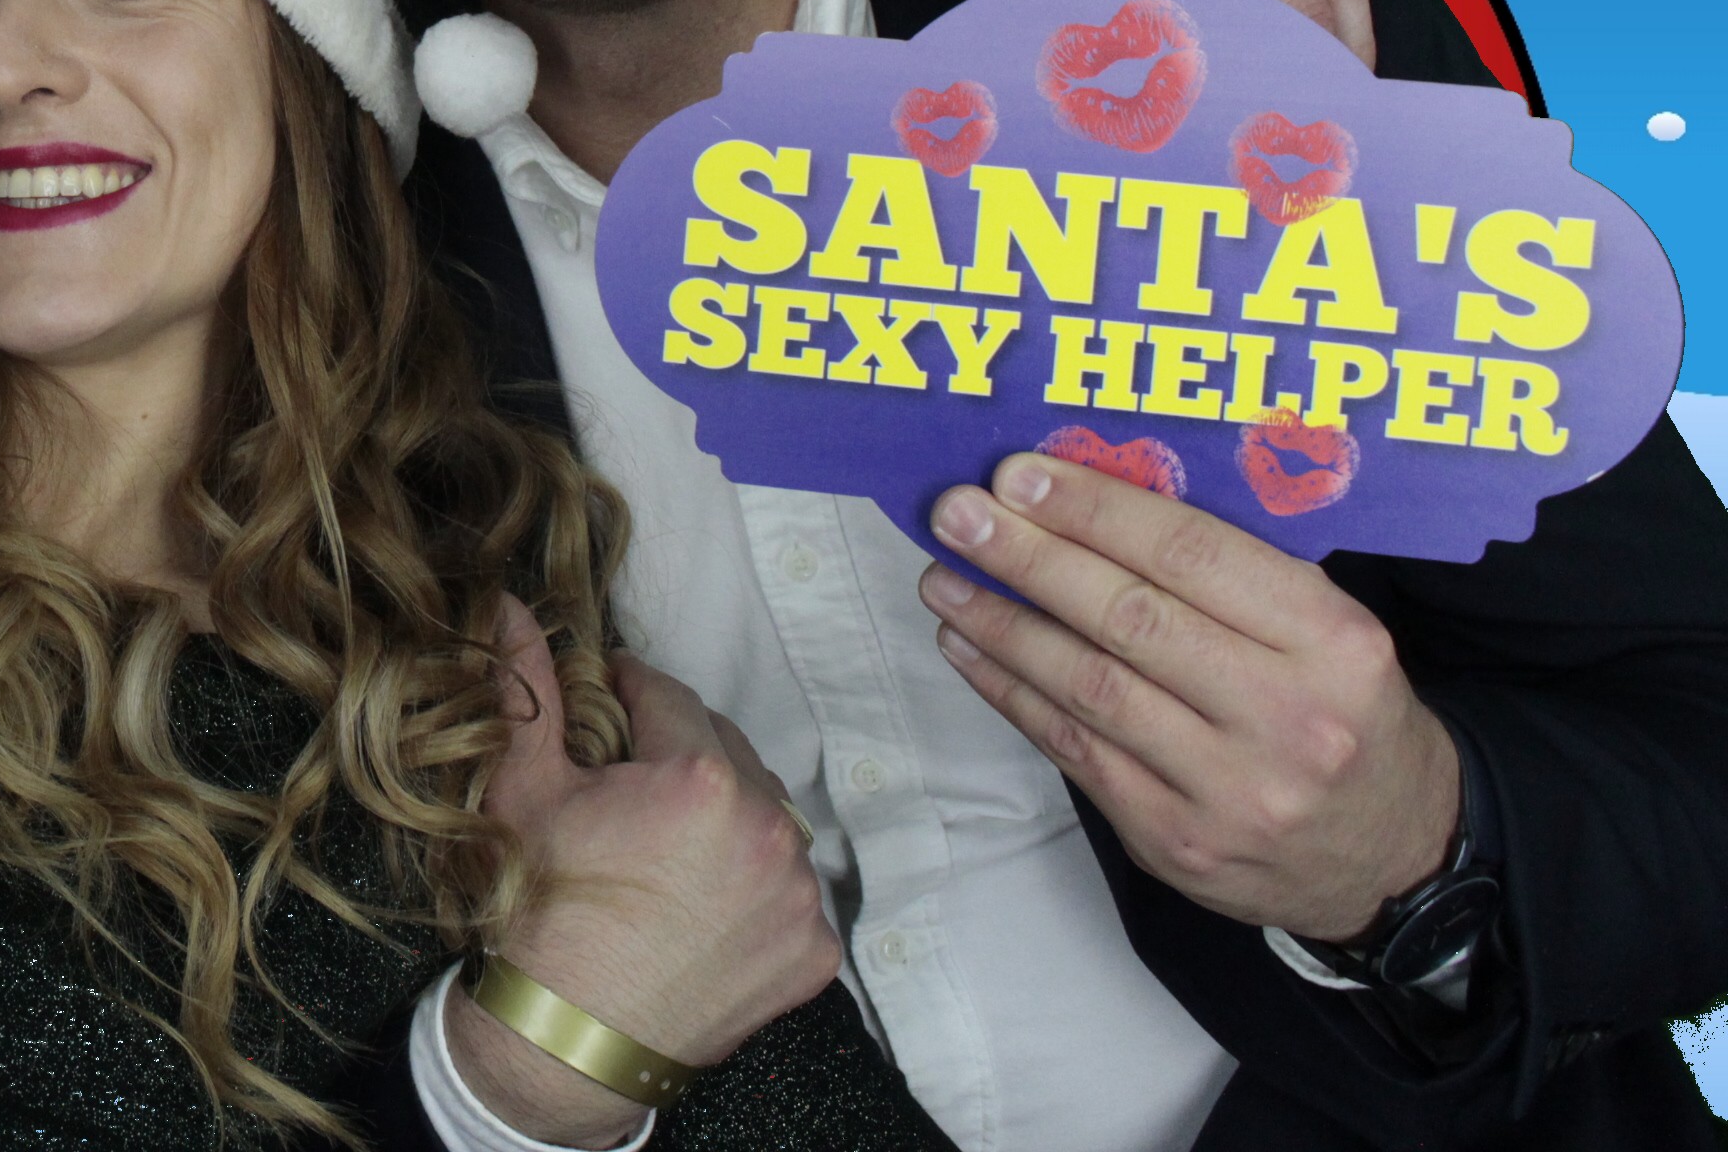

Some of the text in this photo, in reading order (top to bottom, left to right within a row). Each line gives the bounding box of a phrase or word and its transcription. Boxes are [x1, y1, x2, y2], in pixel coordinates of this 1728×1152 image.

[683, 139, 1597, 352] SANTA'S
[663, 278, 1570, 456] SEXY HELPER
